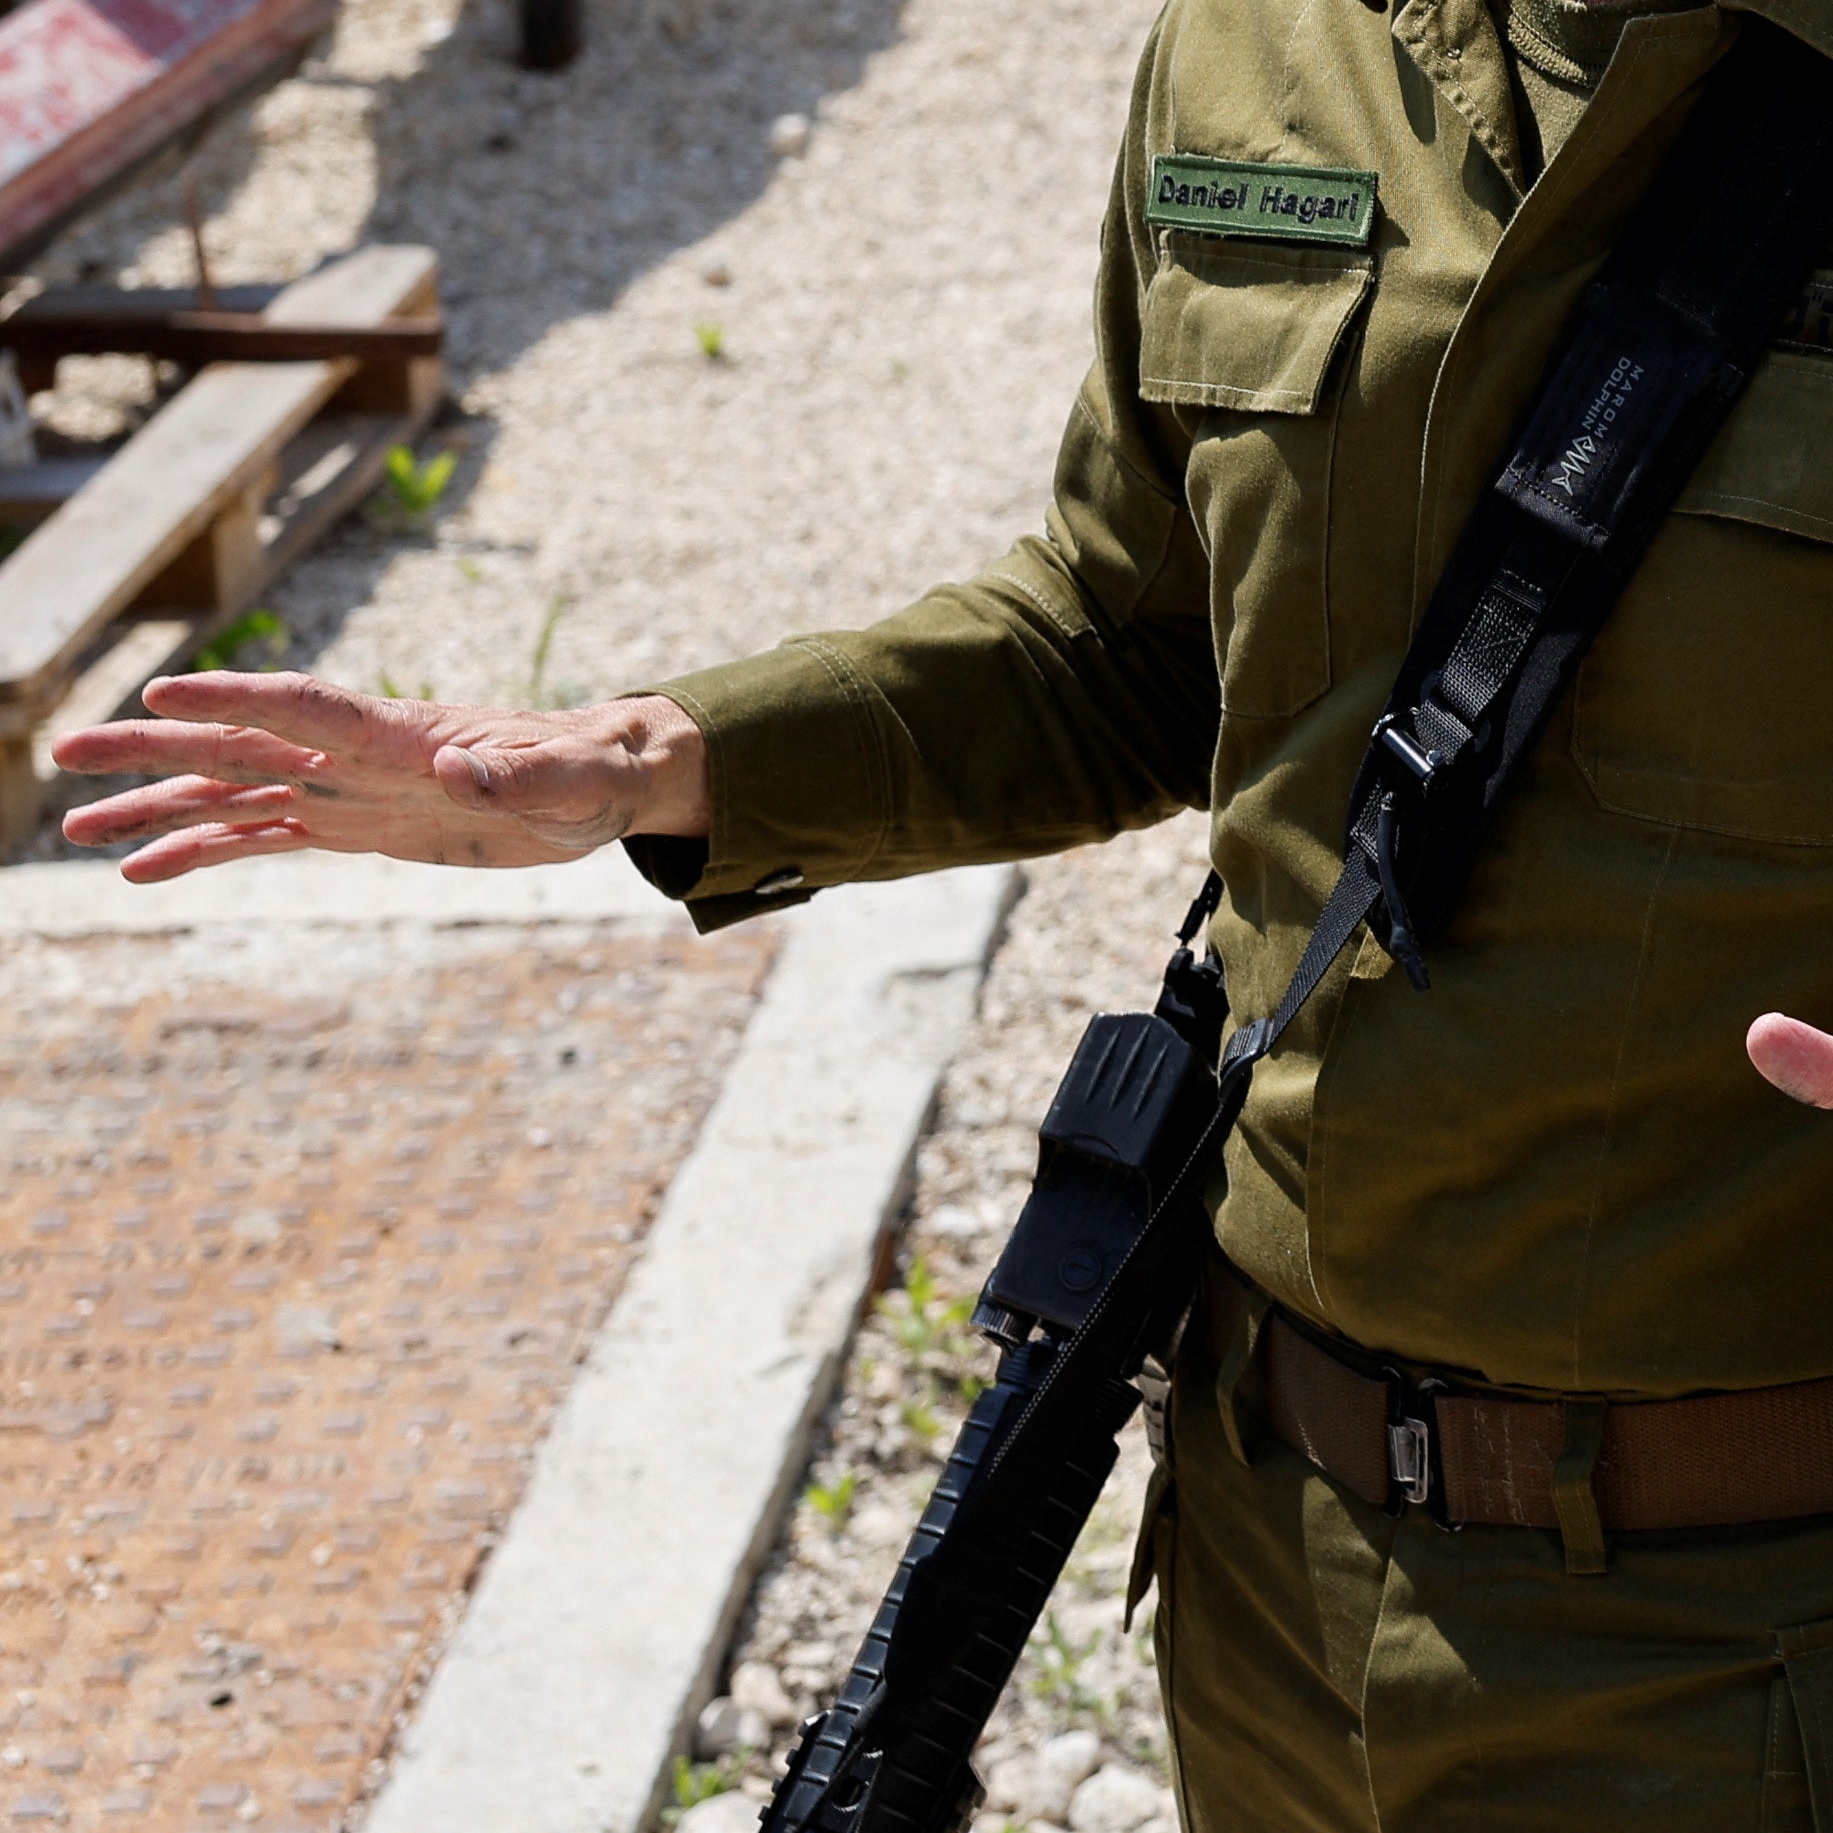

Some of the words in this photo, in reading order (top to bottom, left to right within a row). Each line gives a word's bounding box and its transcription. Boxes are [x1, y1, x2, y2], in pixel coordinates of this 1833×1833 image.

[1158, 174, 1249, 211] Daniel
[1260, 185, 1360, 224] Hagari
[1581, 356, 1631, 430] DOLPHIN
[1593, 364, 1644, 439] MAROM
